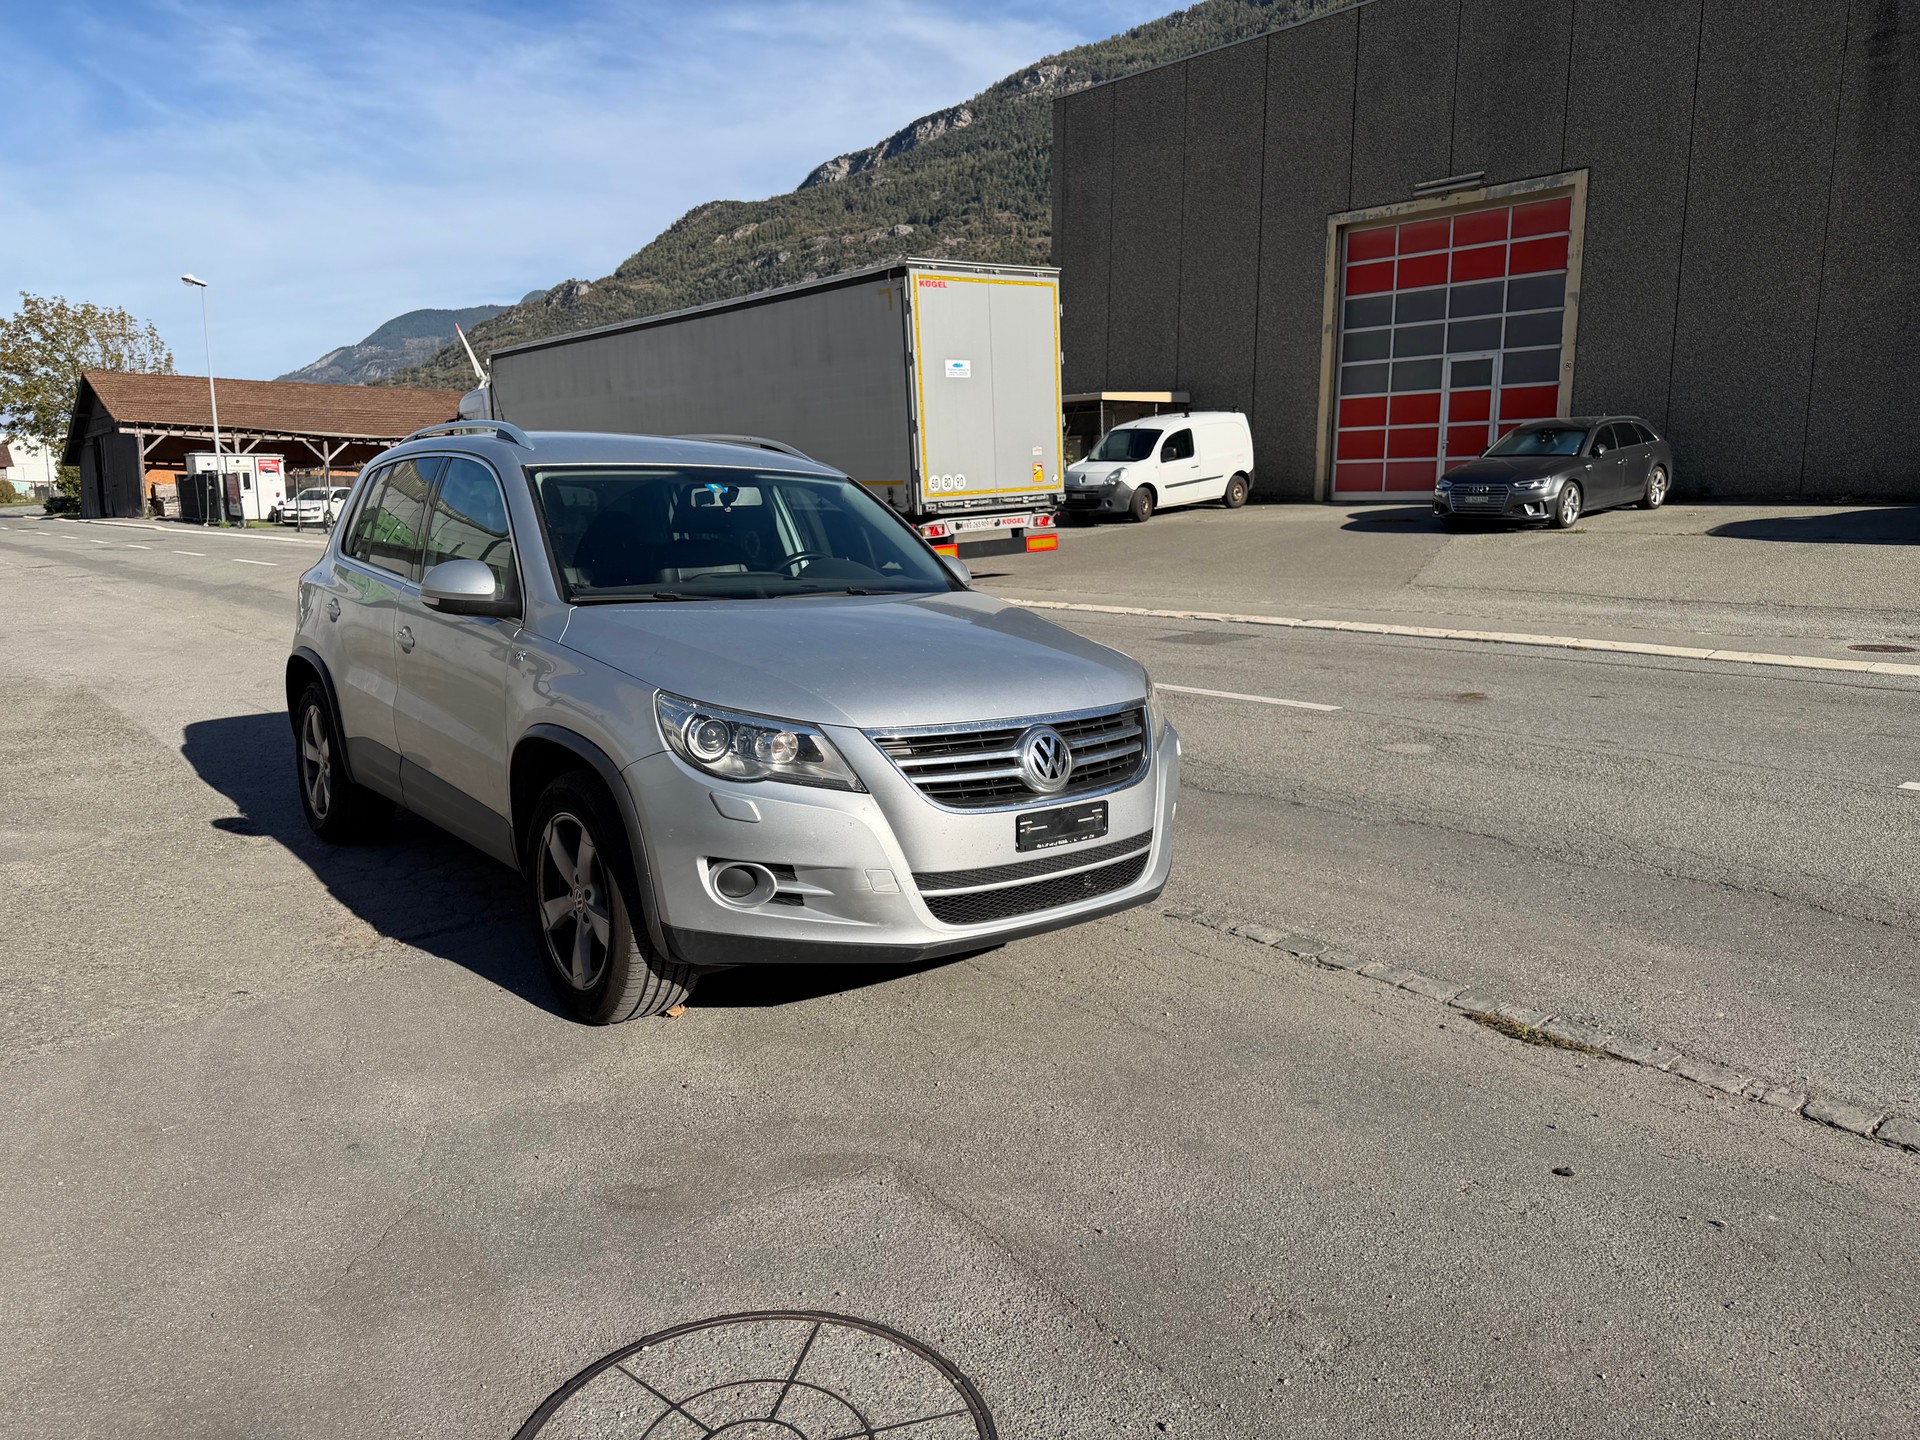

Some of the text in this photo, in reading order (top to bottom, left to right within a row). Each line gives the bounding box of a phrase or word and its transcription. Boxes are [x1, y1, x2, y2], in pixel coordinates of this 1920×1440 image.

[931, 478, 939, 488] 60
[944, 477, 951, 488] 80
[956, 476, 964, 487] 90
[1028, 731, 1068, 783] VW
